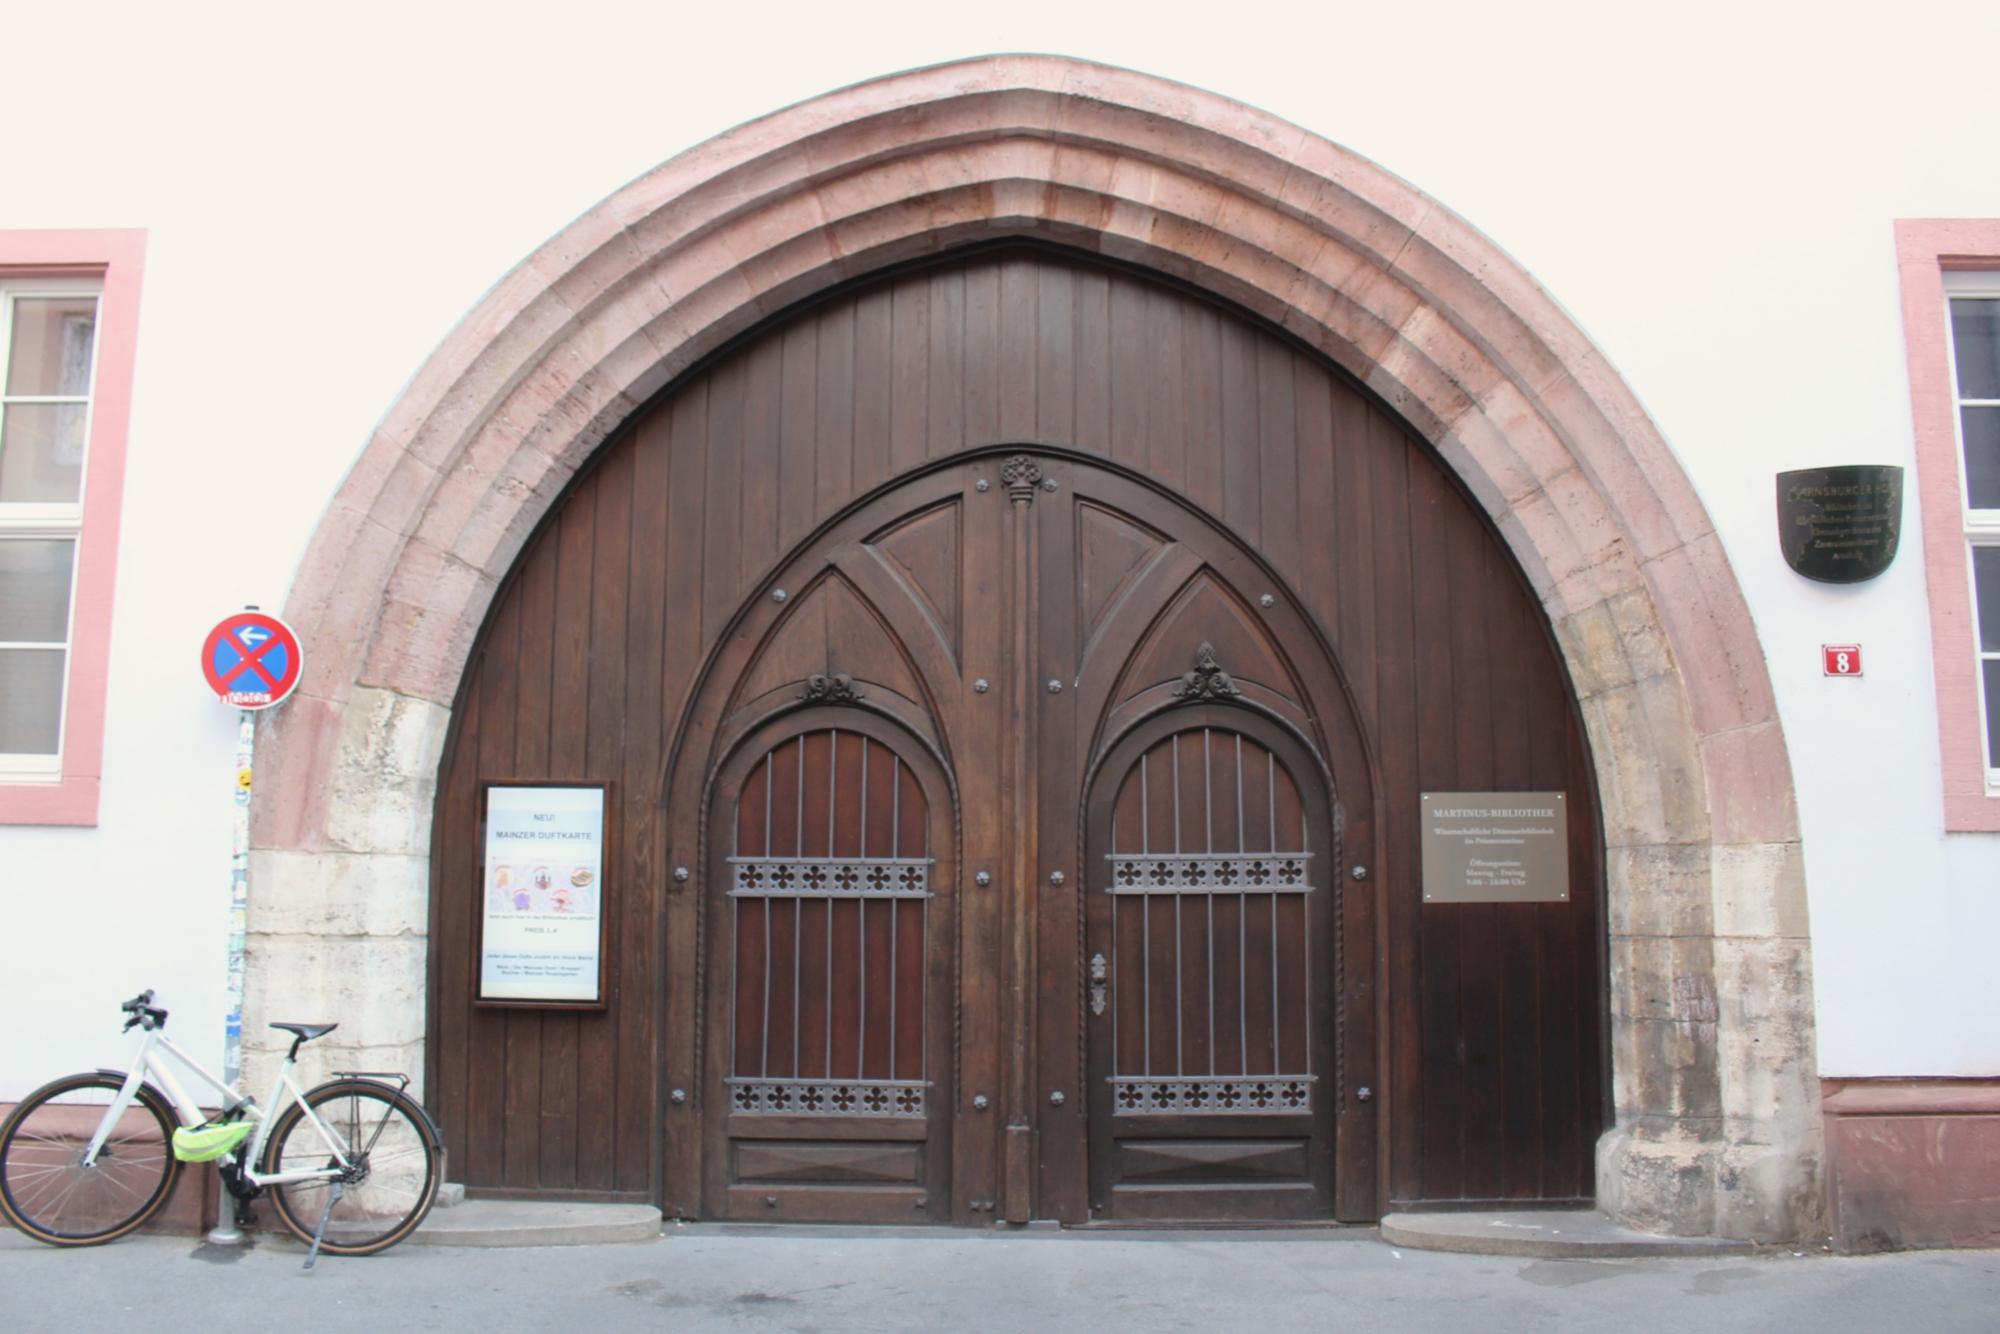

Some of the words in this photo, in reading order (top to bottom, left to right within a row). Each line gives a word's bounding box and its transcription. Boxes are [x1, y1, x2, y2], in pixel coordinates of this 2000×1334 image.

[1837, 652, 1849, 673] 8
[1433, 808, 1555, 818] MARTINUS-BIBLIOTHEK
[496, 831, 536, 839] MAINZER
[538, 832, 592, 840] DUFTKARTE
